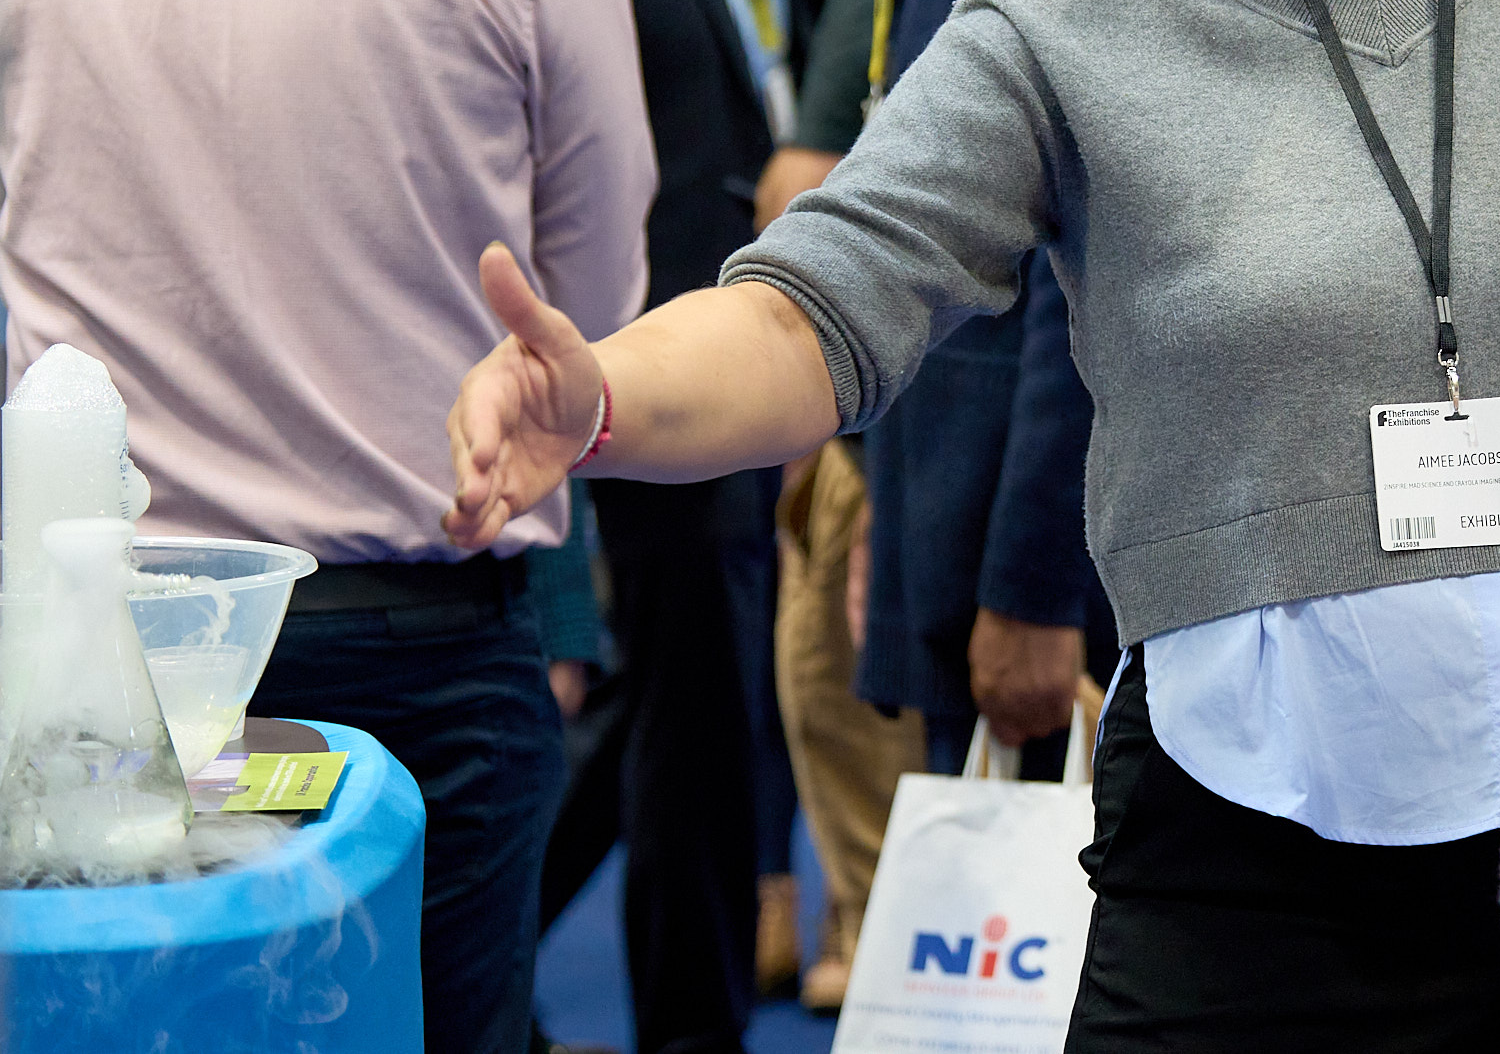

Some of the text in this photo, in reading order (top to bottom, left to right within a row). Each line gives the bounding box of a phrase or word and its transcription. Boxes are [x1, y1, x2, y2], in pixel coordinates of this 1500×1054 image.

[1388, 418, 1431, 427] Exhibitions
[1418, 454, 1455, 468] AIMEE
[1455, 479, 1478, 487] CRAYOLA
[1479, 477, 1500, 485] IMAGINE
